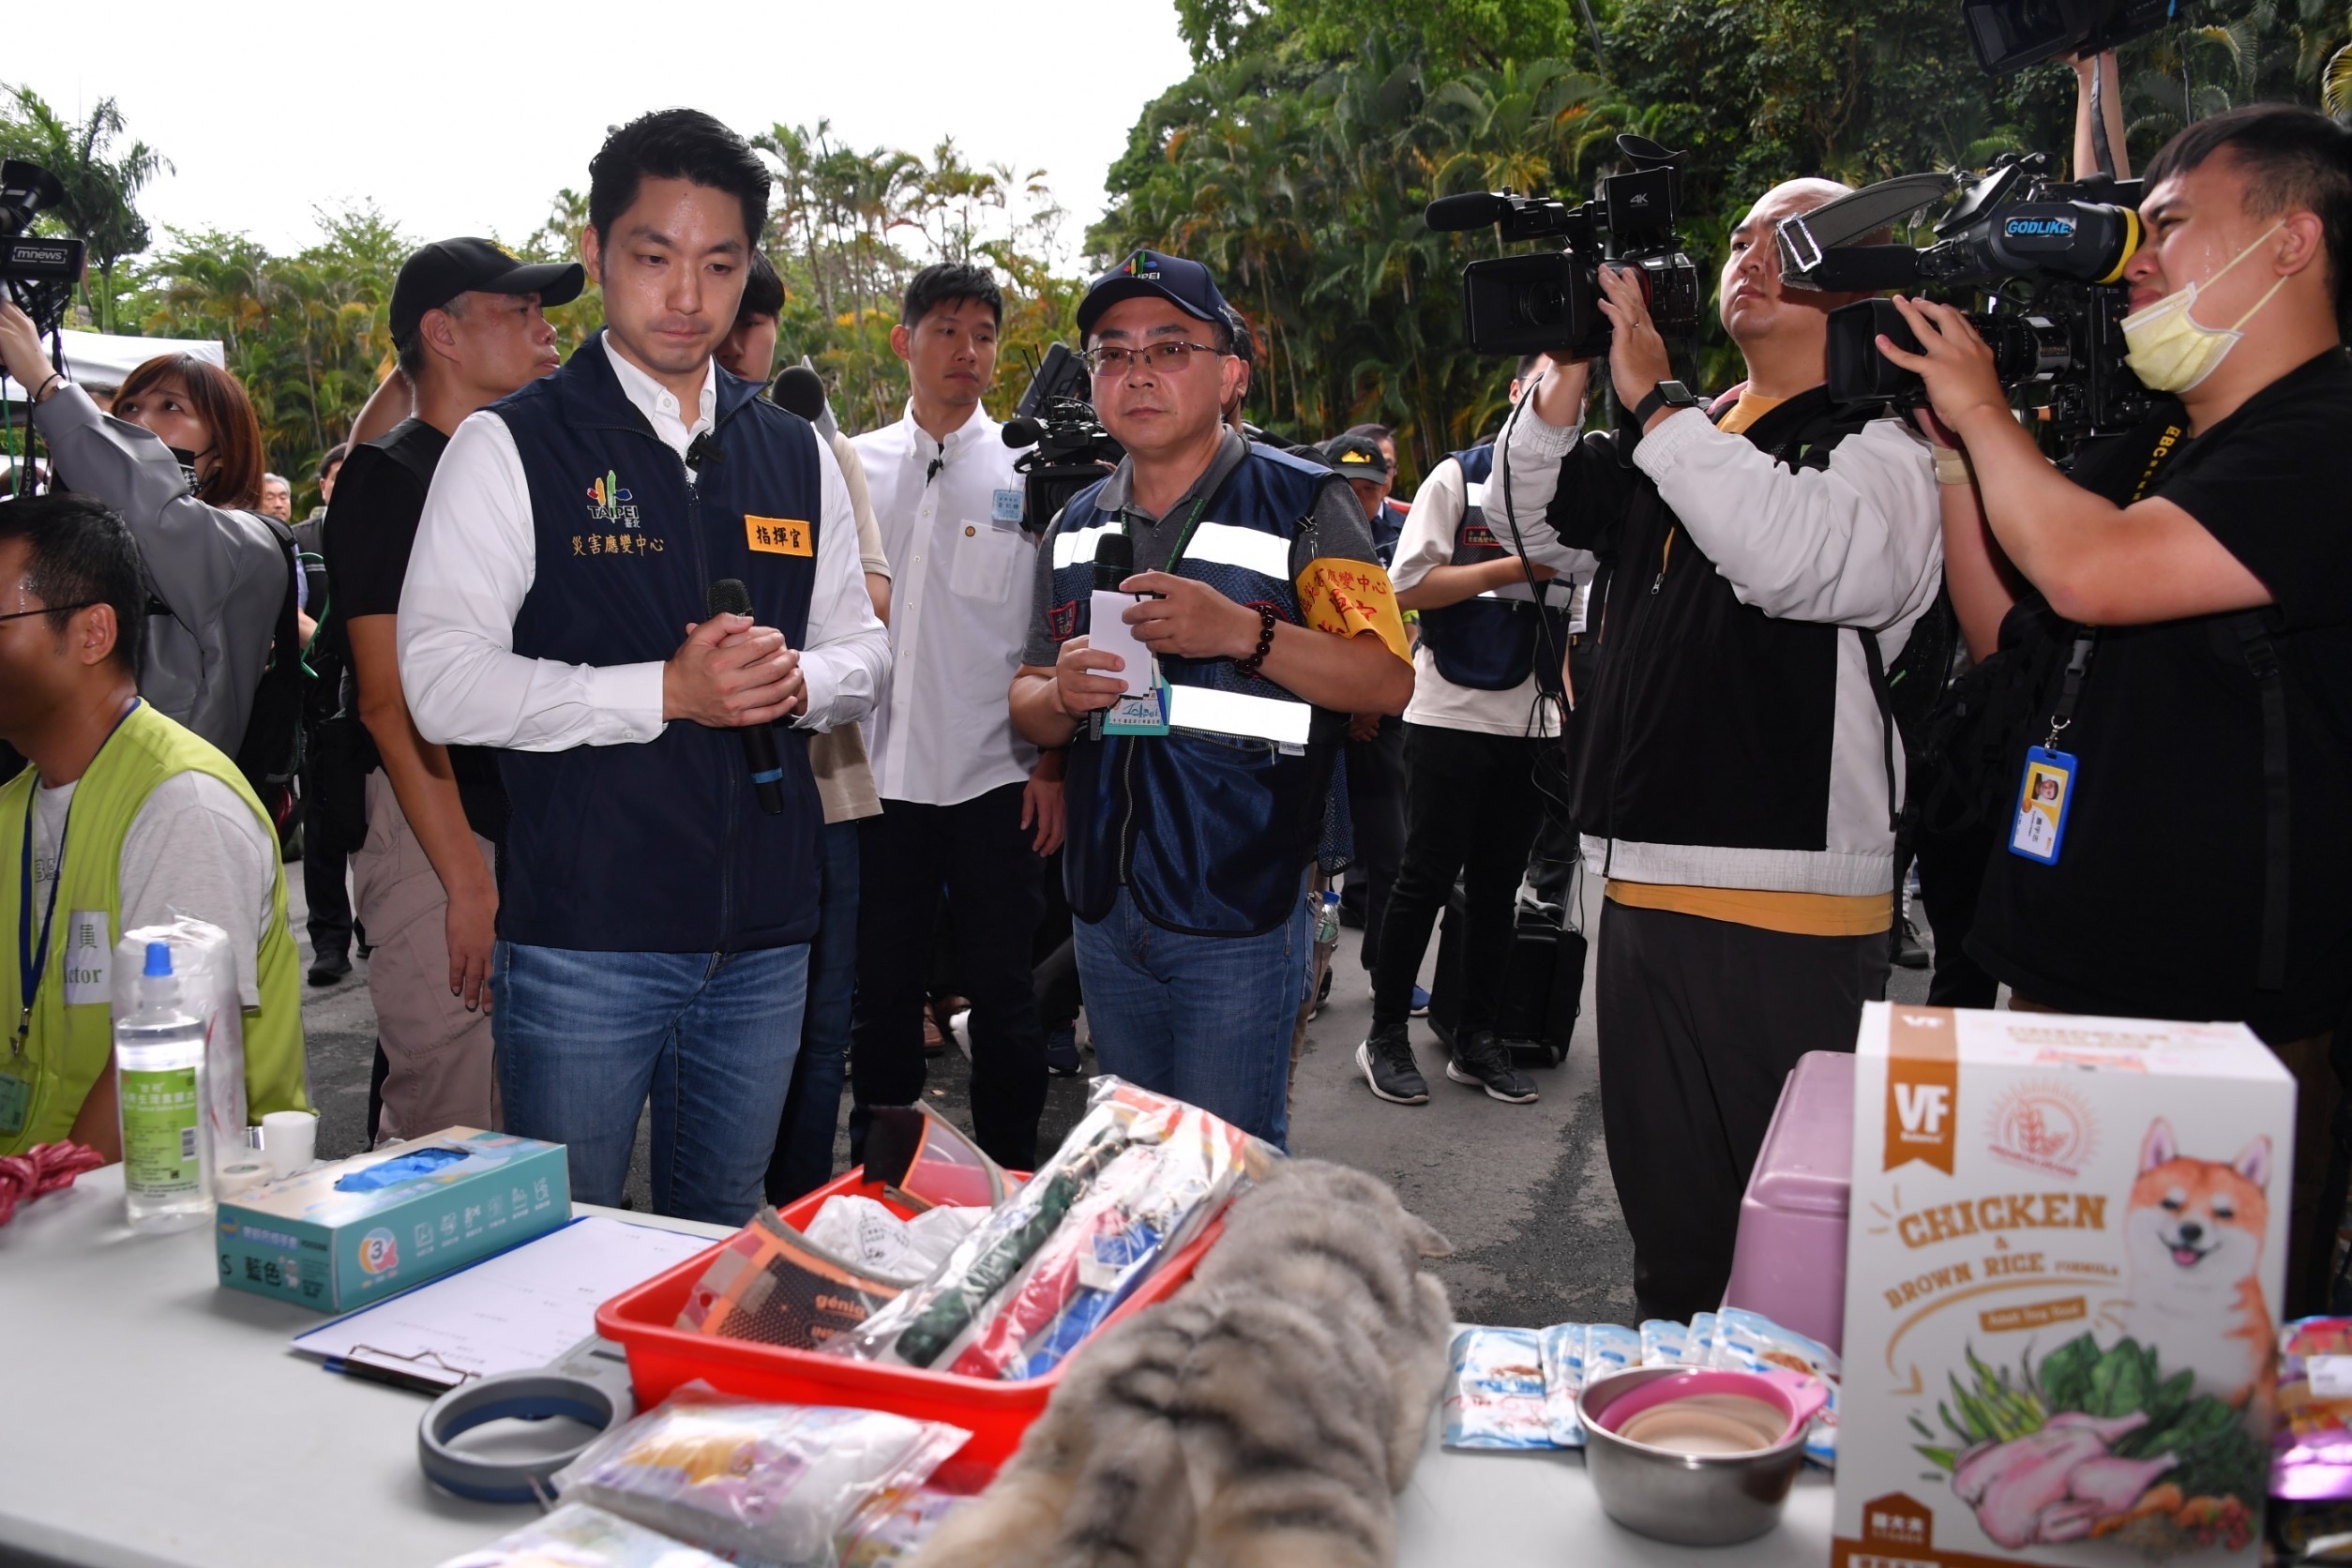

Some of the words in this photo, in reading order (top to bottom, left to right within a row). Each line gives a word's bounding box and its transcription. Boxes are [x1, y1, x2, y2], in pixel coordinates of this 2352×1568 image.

[1630, 193, 1649, 204] 4K
[2007, 220, 2070, 234] GODLIKE
[18, 249, 62, 261] mnews
[587, 505, 640, 520] TAIPEI
[571, 533, 665, 557] 災害應變中心
[756, 525, 801, 549] 指揮官
[65, 967, 103, 984] ctor
[1893, 1082, 1950, 1133] VF
[1897, 1193, 2109, 1250] CHICKEN
[370, 1240, 384, 1260] 3
[1883, 1262, 1973, 1310] BROWN
[1983, 1252, 2045, 1277] RICE
